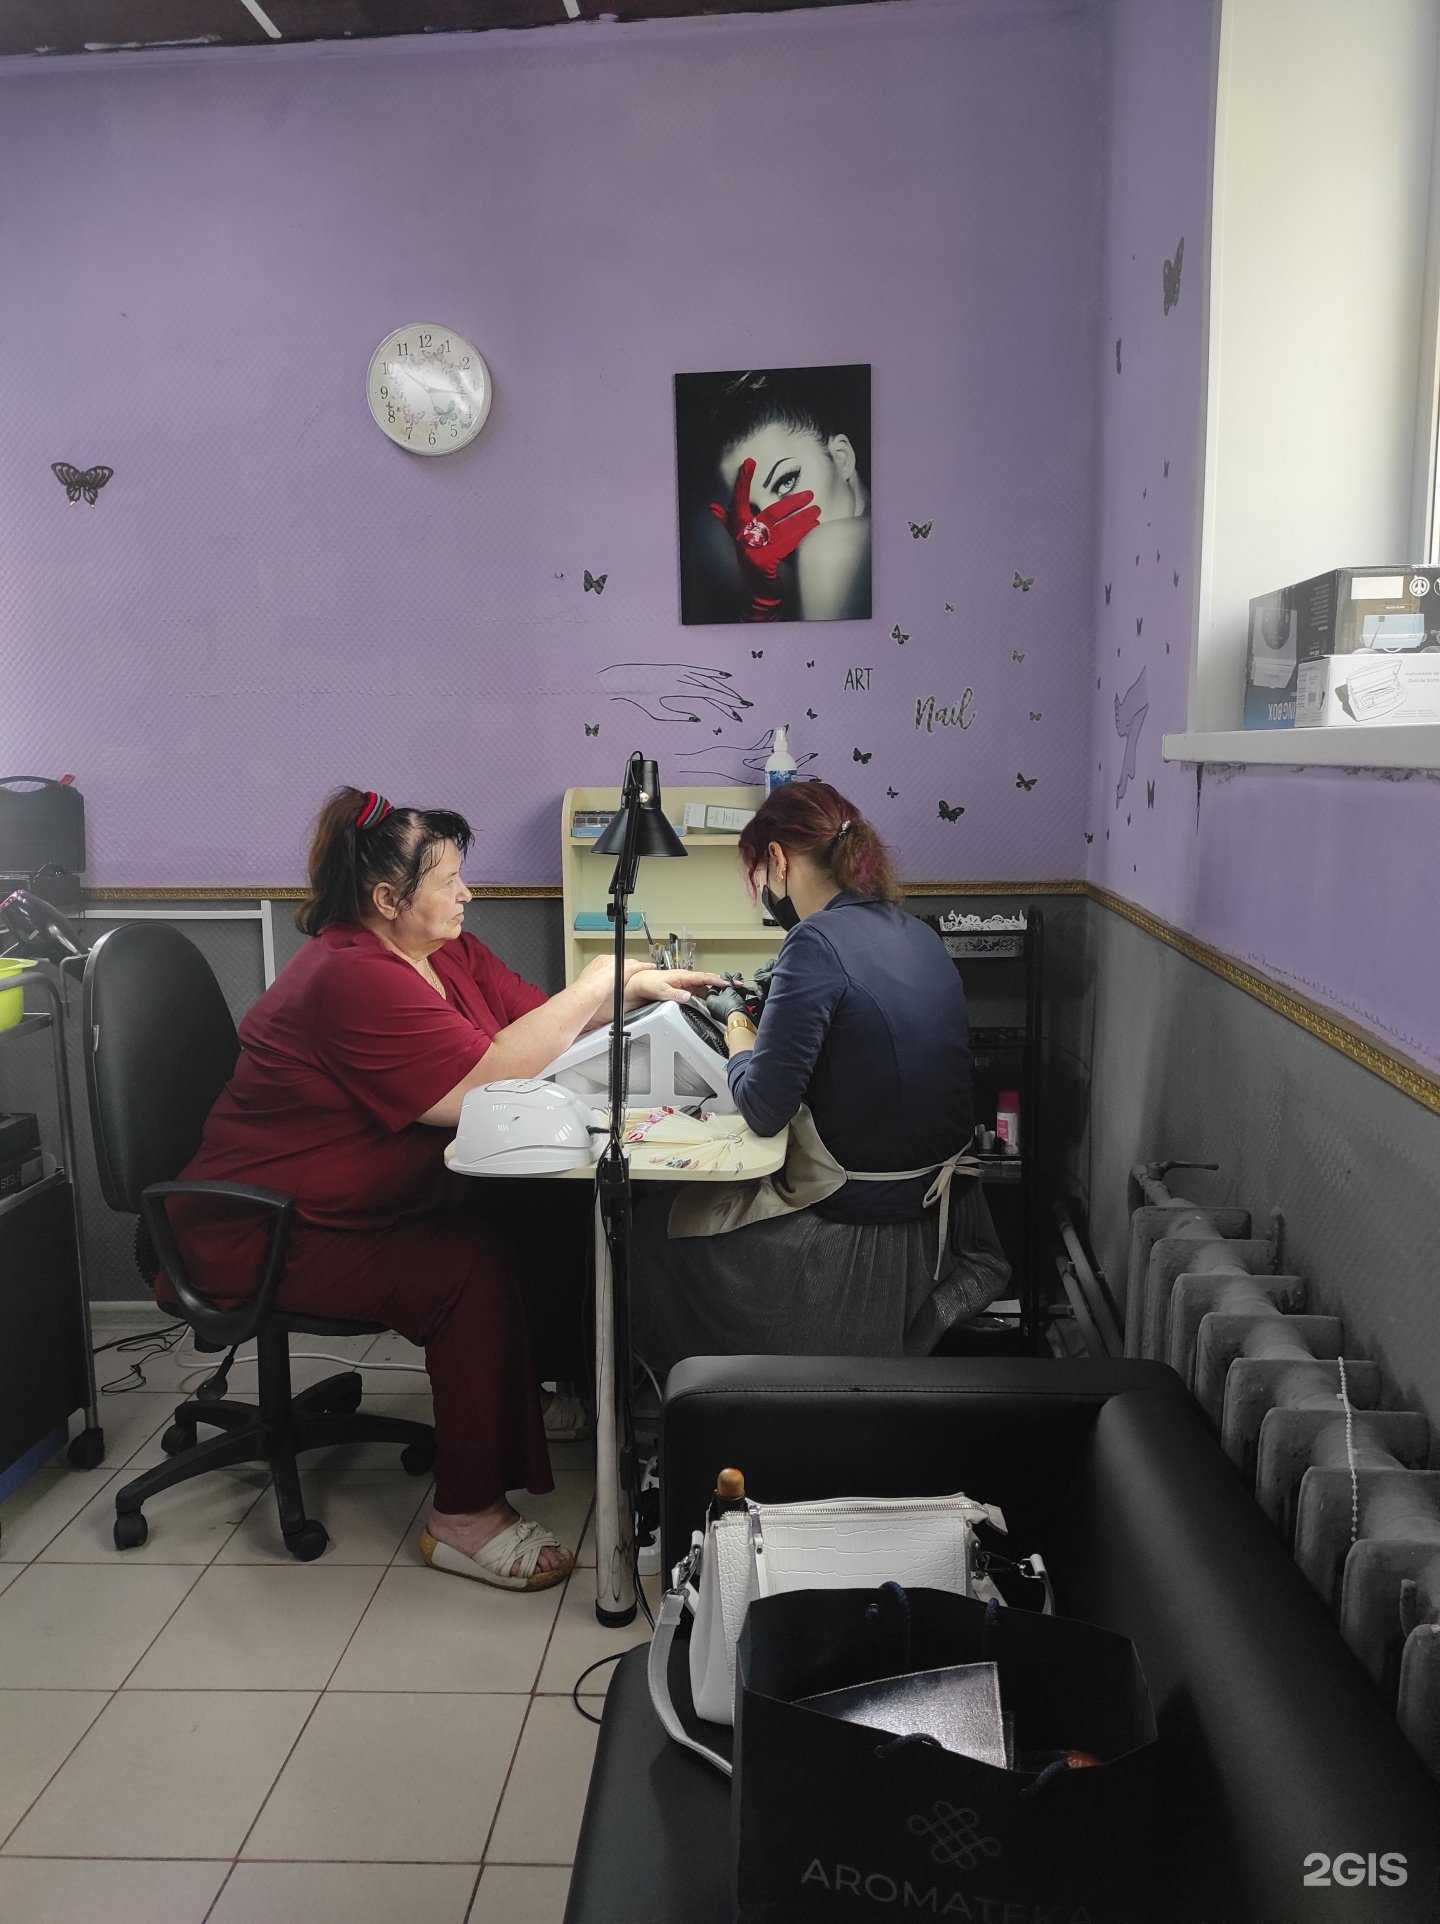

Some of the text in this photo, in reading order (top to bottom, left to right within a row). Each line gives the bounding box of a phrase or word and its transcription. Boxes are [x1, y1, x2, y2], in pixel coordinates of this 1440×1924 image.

[419, 334, 432, 348] 12
[445, 340, 452, 353] 1
[397, 343, 409, 356] 11
[462, 356, 471, 370] 2
[380, 386, 389, 400] 9
[387, 410, 396, 424] 8
[405, 426, 413, 441] 7
[449, 424, 458, 438] 5
[428, 432, 437, 446] 6
[844, 667, 874, 691] ART
